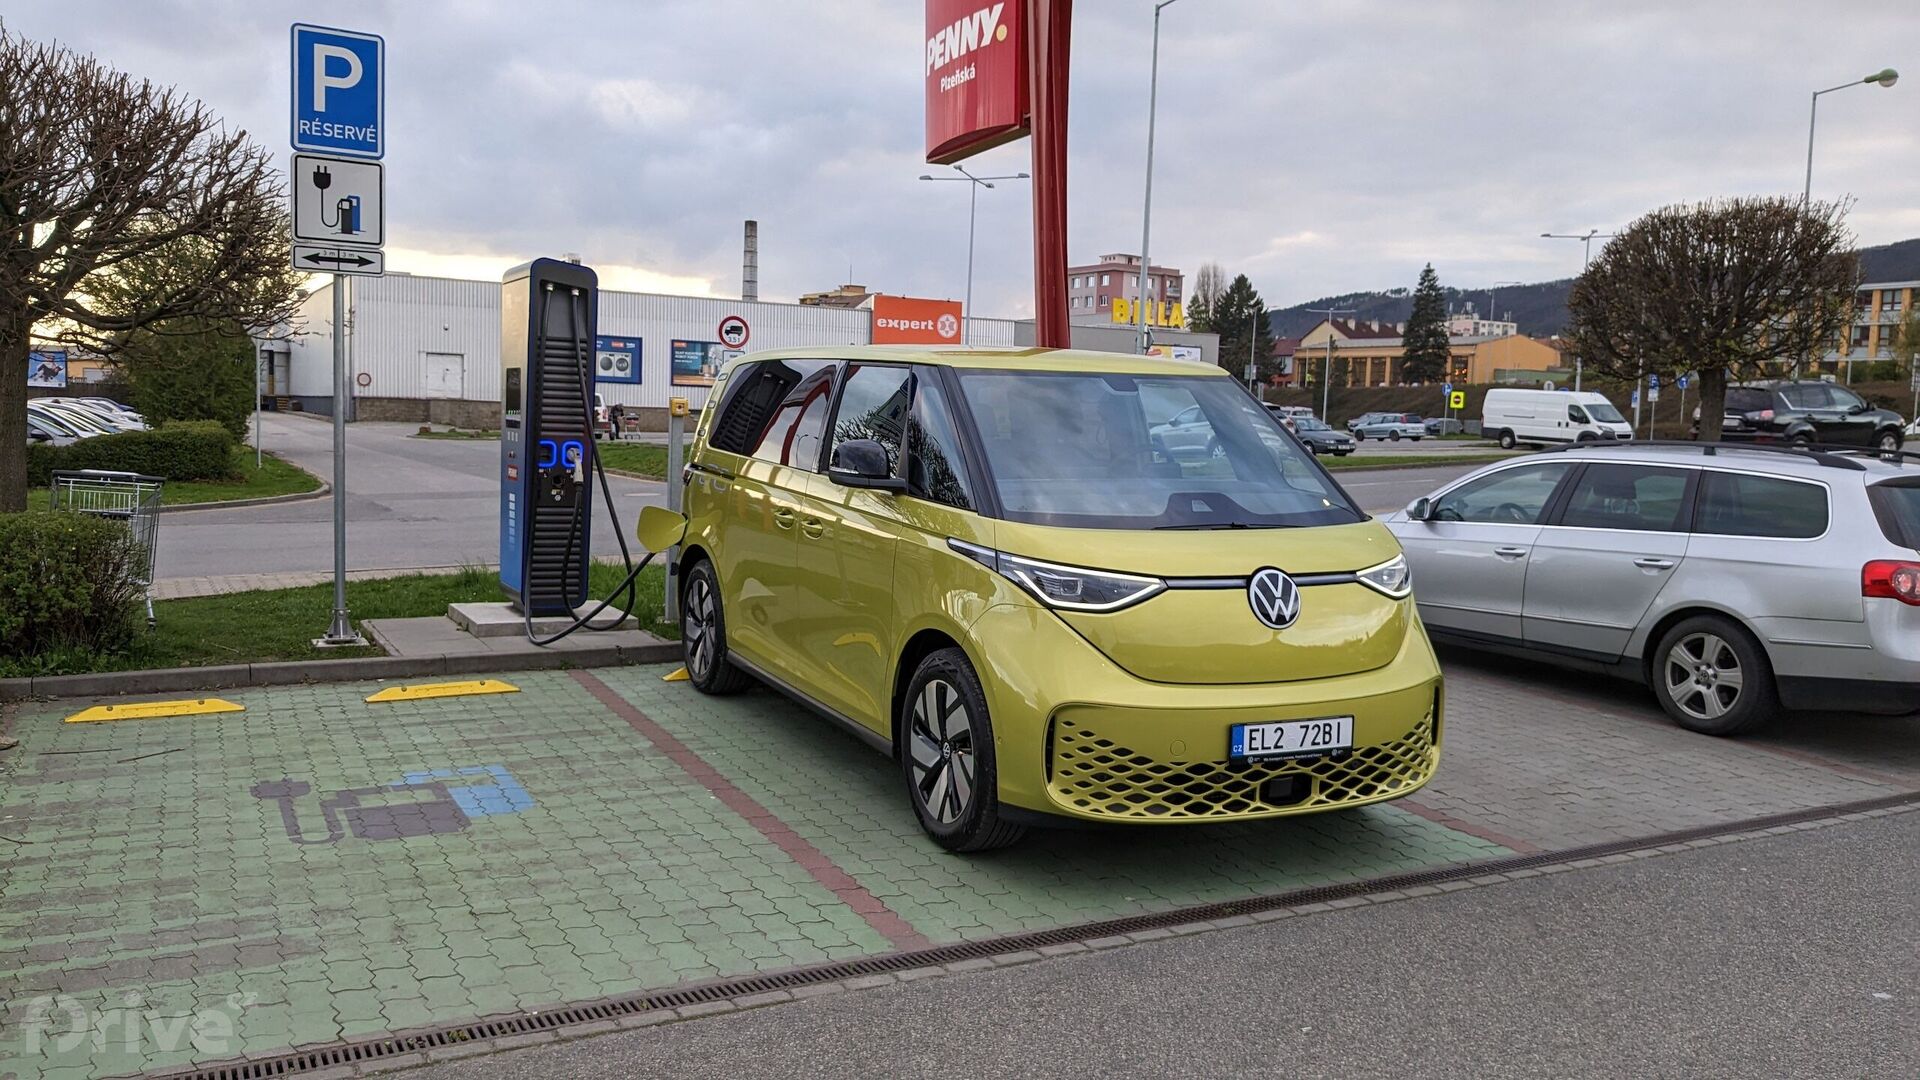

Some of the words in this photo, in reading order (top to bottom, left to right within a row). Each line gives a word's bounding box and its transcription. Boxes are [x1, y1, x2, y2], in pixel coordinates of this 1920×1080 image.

[313, 43, 363, 113] P
[940, 62, 976, 93] Plzeňská
[299, 117, 377, 143] RÉSERVÉ
[876, 318, 934, 331] expert
[1113, 298, 1185, 328] BILLA
[1232, 744, 1243, 753] CZ
[1248, 726, 1285, 752] EL2
